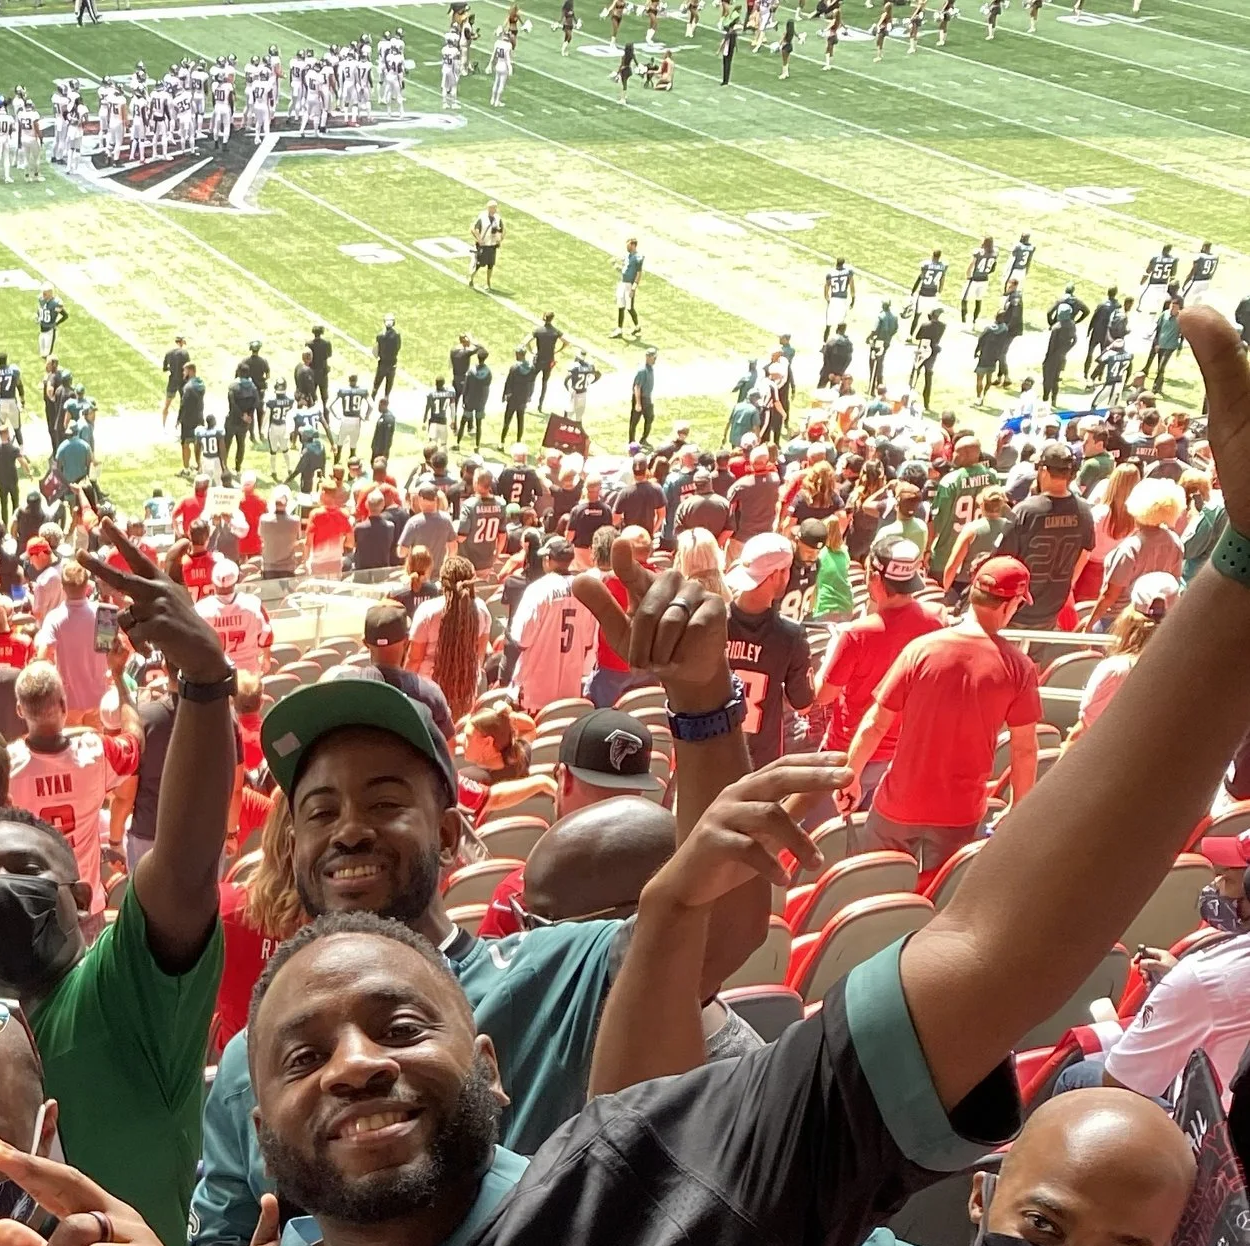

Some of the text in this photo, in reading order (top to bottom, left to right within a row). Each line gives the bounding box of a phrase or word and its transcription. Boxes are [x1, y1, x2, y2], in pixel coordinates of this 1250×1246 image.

[923, 270, 943, 286] 54
[1152, 263, 1174, 280] 55
[830, 279, 848, 294] 57
[1109, 360, 1130, 378] 42
[343, 395, 362, 412] 19
[510, 482, 525, 502] 2
[473, 518, 501, 544] 20
[560, 608, 577, 654] 5
[35, 773, 74, 797] RYAN
